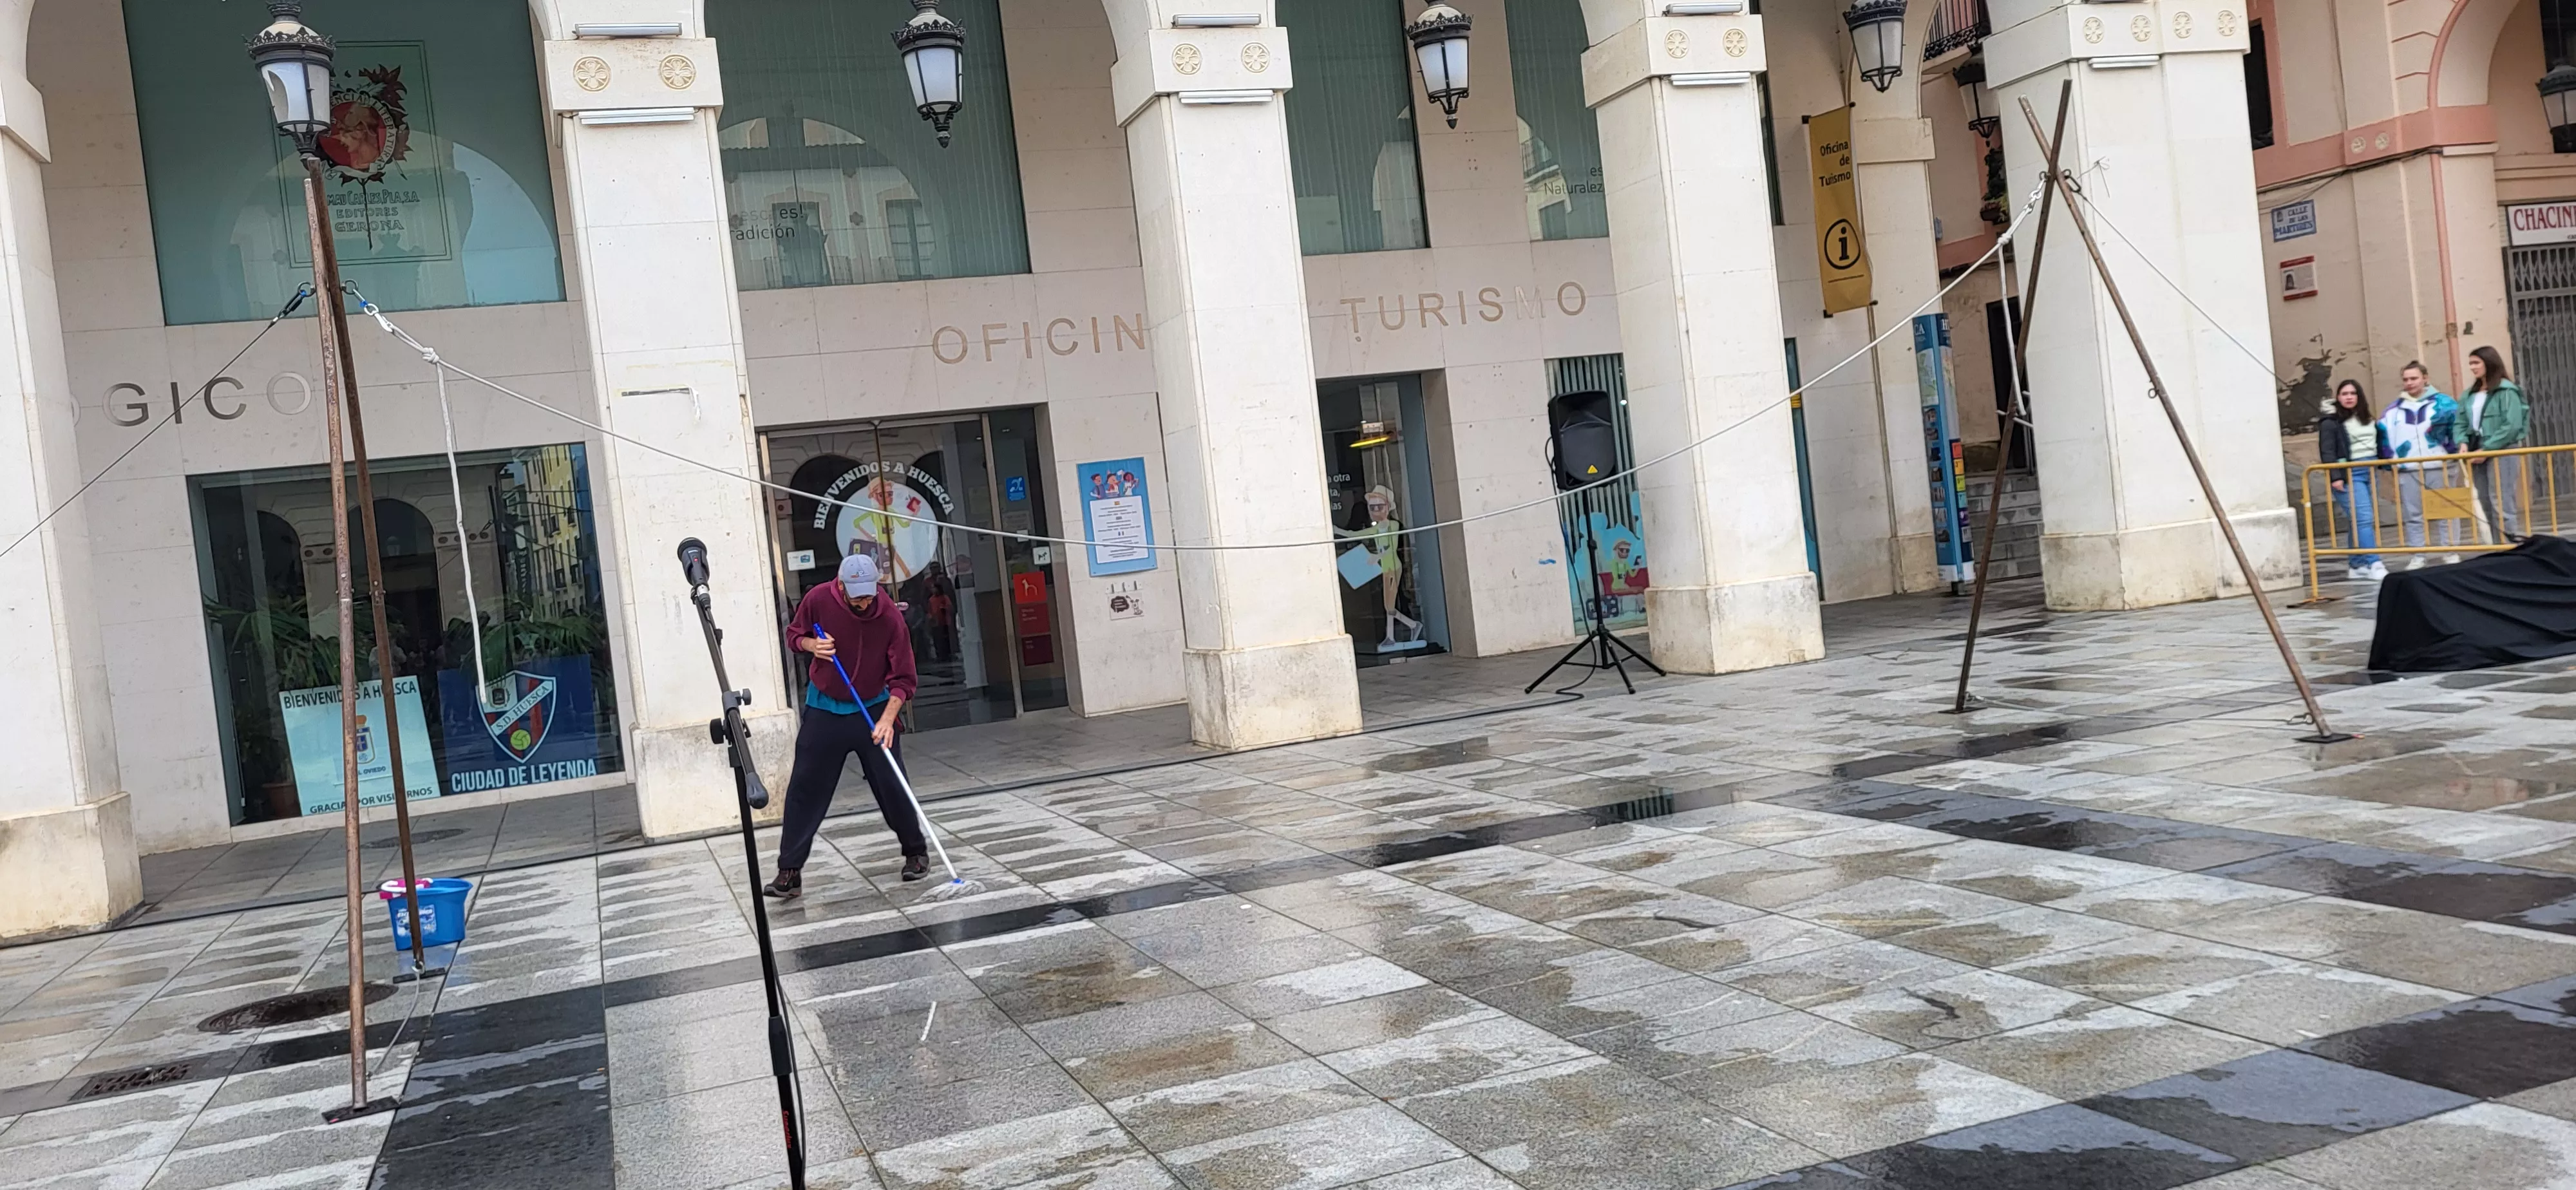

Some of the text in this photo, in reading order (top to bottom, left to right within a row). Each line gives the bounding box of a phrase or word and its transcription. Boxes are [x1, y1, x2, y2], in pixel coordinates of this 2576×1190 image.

[1819, 140, 1849, 156] Oficina
[1839, 153, 1850, 166] de
[336, 206, 399, 219] EDITORES
[2513, 205, 2576, 231] CHACIN
[334, 220, 404, 232] GERONA
[1340, 281, 1587, 334] TURISMO
[70, 371, 312, 427] GICO
[1333, 473, 1350, 482] otra
[813, 460, 955, 530] BIENVENIDOS A HUESCA
[363, 688, 372, 699] A
[374, 681, 417, 699] HSCA
[496, 685, 550, 730] S.D. HUESCA
[363, 766, 386, 775] OVIEDO
[451, 758, 598, 793] CIUDAD DE LEYENDA
[310, 786, 433, 814] GRACIA OR VISIRNOS
